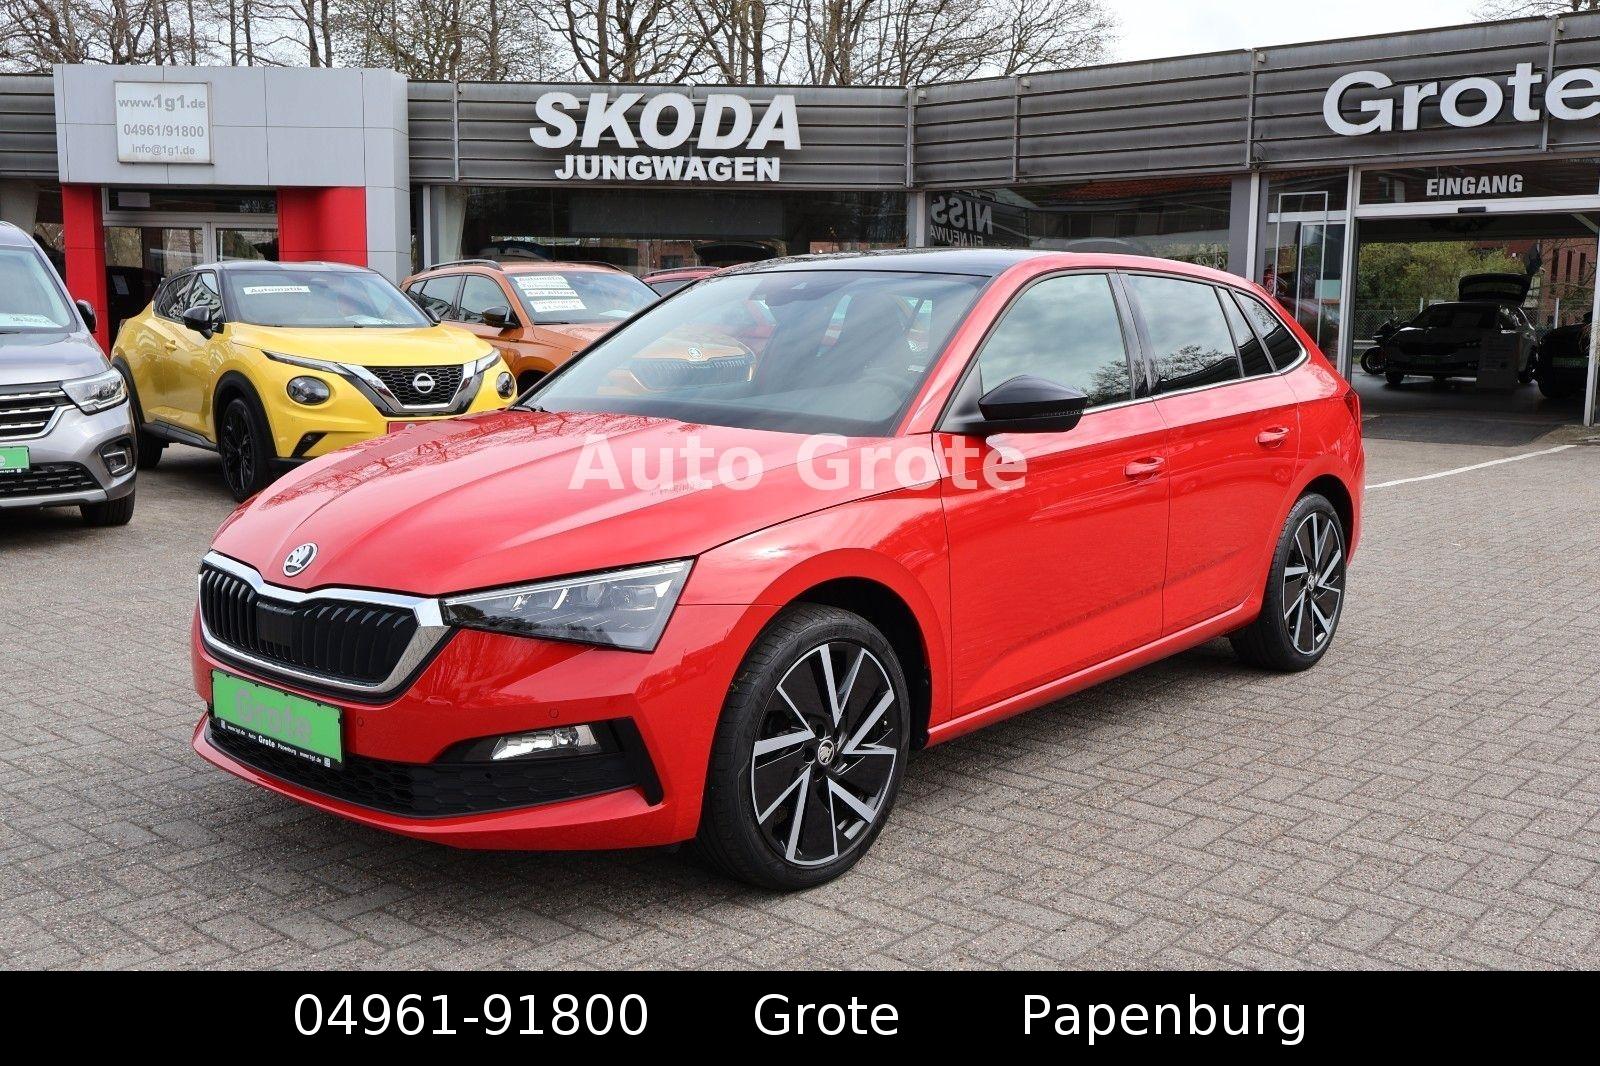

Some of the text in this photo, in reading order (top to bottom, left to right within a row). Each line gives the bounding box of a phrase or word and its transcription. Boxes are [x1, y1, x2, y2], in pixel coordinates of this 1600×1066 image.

[118, 94, 206, 112] www.1g1.de
[1322, 62, 1600, 136] Grote
[123, 123, 204, 138] 04961/91800
[529, 91, 802, 150] SKODA
[554, 154, 780, 182] JUNGWAGEN
[1426, 174, 1523, 196] EINGANG
[258, 735, 275, 748] Grote
